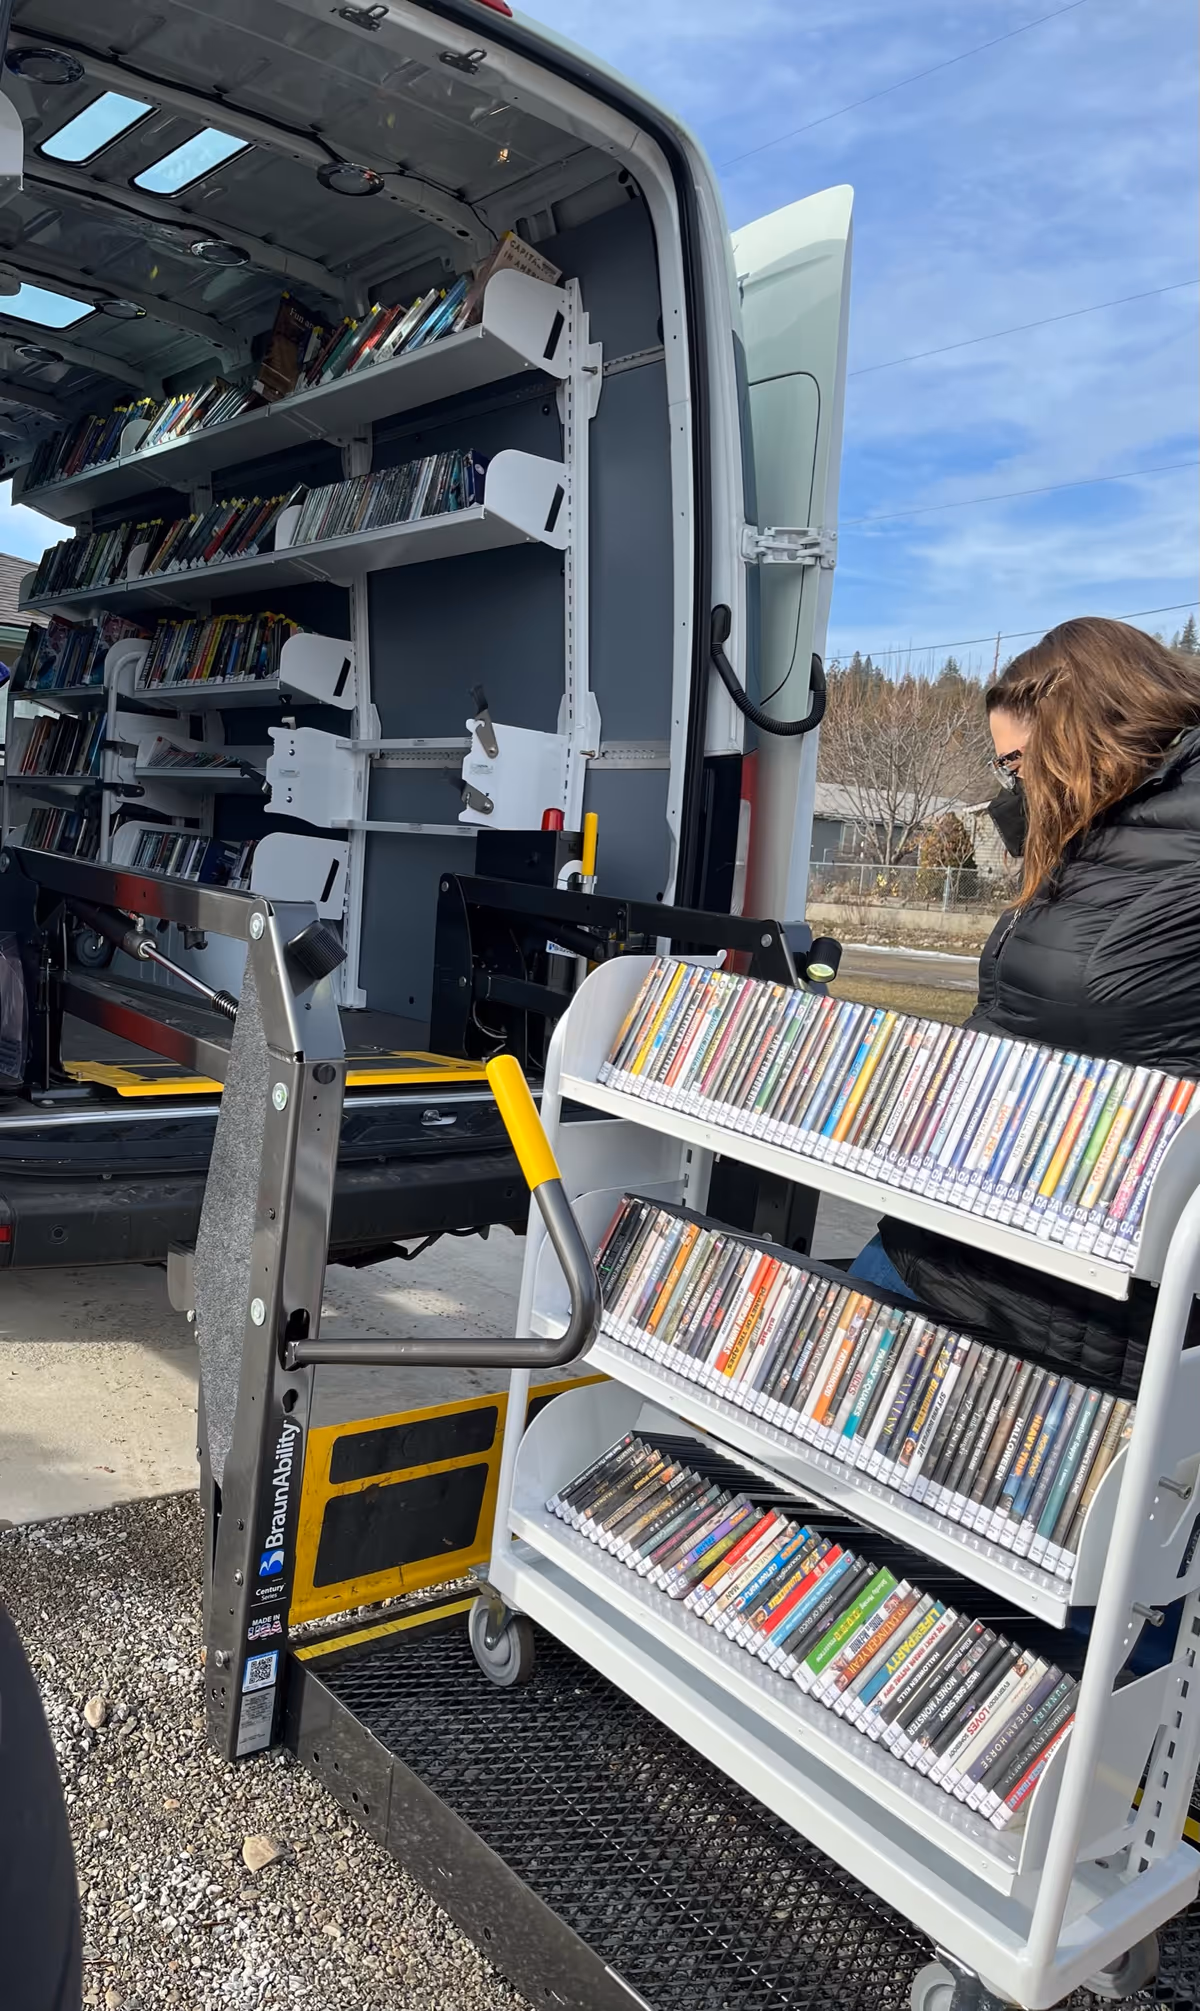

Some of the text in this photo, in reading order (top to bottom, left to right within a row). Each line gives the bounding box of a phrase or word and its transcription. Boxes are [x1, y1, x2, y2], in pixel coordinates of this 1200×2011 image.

[513, 260, 546, 282] AMERI
[764, 1033, 782, 1061] EARTH
[777, 1049, 798, 1084] PREY
[744, 1061, 769, 1106] EMERGENCY
[965, 1106, 982, 1135] FROZEN
[700, 1286, 723, 1328] HUSTLERS
[735, 1291, 755, 1325] AMERICAN
[749, 1286, 767, 1318] PLANET
[721, 1323, 741, 1355] ANIMALS
[736, 1330, 748, 1347] THE
[744, 1318, 753, 1330] OF
[817, 1304, 841, 1350] CHILDREN
[726, 1346, 740, 1370] APES
[810, 1349, 823, 1369] ACT
[823, 1347, 849, 1397] FATHERHOOD
[869, 1347, 886, 1378] FAMILY
[881, 1349, 898, 1376] NUN
[847, 1368, 864, 1396] KICKS
[852, 1377, 874, 1418] SQUARES
[935, 1391, 947, 1408] SPY
[945, 1397, 974, 1458] 47 RONIN
[915, 1443, 926, 1457] ME
[994, 1416, 1024, 1481] HALLOWEEN
[1013, 1413, 1043, 1477] HEAVY TRIP
[1071, 1429, 1099, 1494] MADELINE'S MADELINE
[265, 1420, 300, 1549] BraunAbility
[665, 1491, 694, 1518] CHAPTER
[648, 1518, 663, 1533] TWO
[256, 1584, 285, 1596] Century
[261, 1593, 278, 1601] Series
[724, 1583, 740, 1600] MAN
[816, 1593, 834, 1612] HOUSE
[252, 1613, 281, 1626] MADE IN
[797, 1616, 814, 1634] GUCCI
[810, 1609, 820, 1619] OF
[917, 1607, 940, 1634] LIFE
[247, 1620, 283, 1641] USA
[864, 1611, 901, 1653] SALINGER
[846, 1649, 869, 1674] YEAR
[883, 1635, 917, 1675] PARTY
[908, 1650, 940, 1688] HALLOWEEN
[895, 1685, 912, 1704] KILLS
[932, 1675, 958, 1704] MONEY
[936, 1669, 980, 1721] WEST SIDE STORY
[1031, 1682, 1067, 1725] DUNKIRK
[906, 1699, 937, 1736] MONSTER
[947, 1680, 1010, 1759] EVERYBODY LOVES SOMEBODY
[1004, 1702, 1034, 1738] DREAM
[1043, 1703, 1071, 1736] RESIDENT
[979, 1735, 1007, 1769] HORSE
